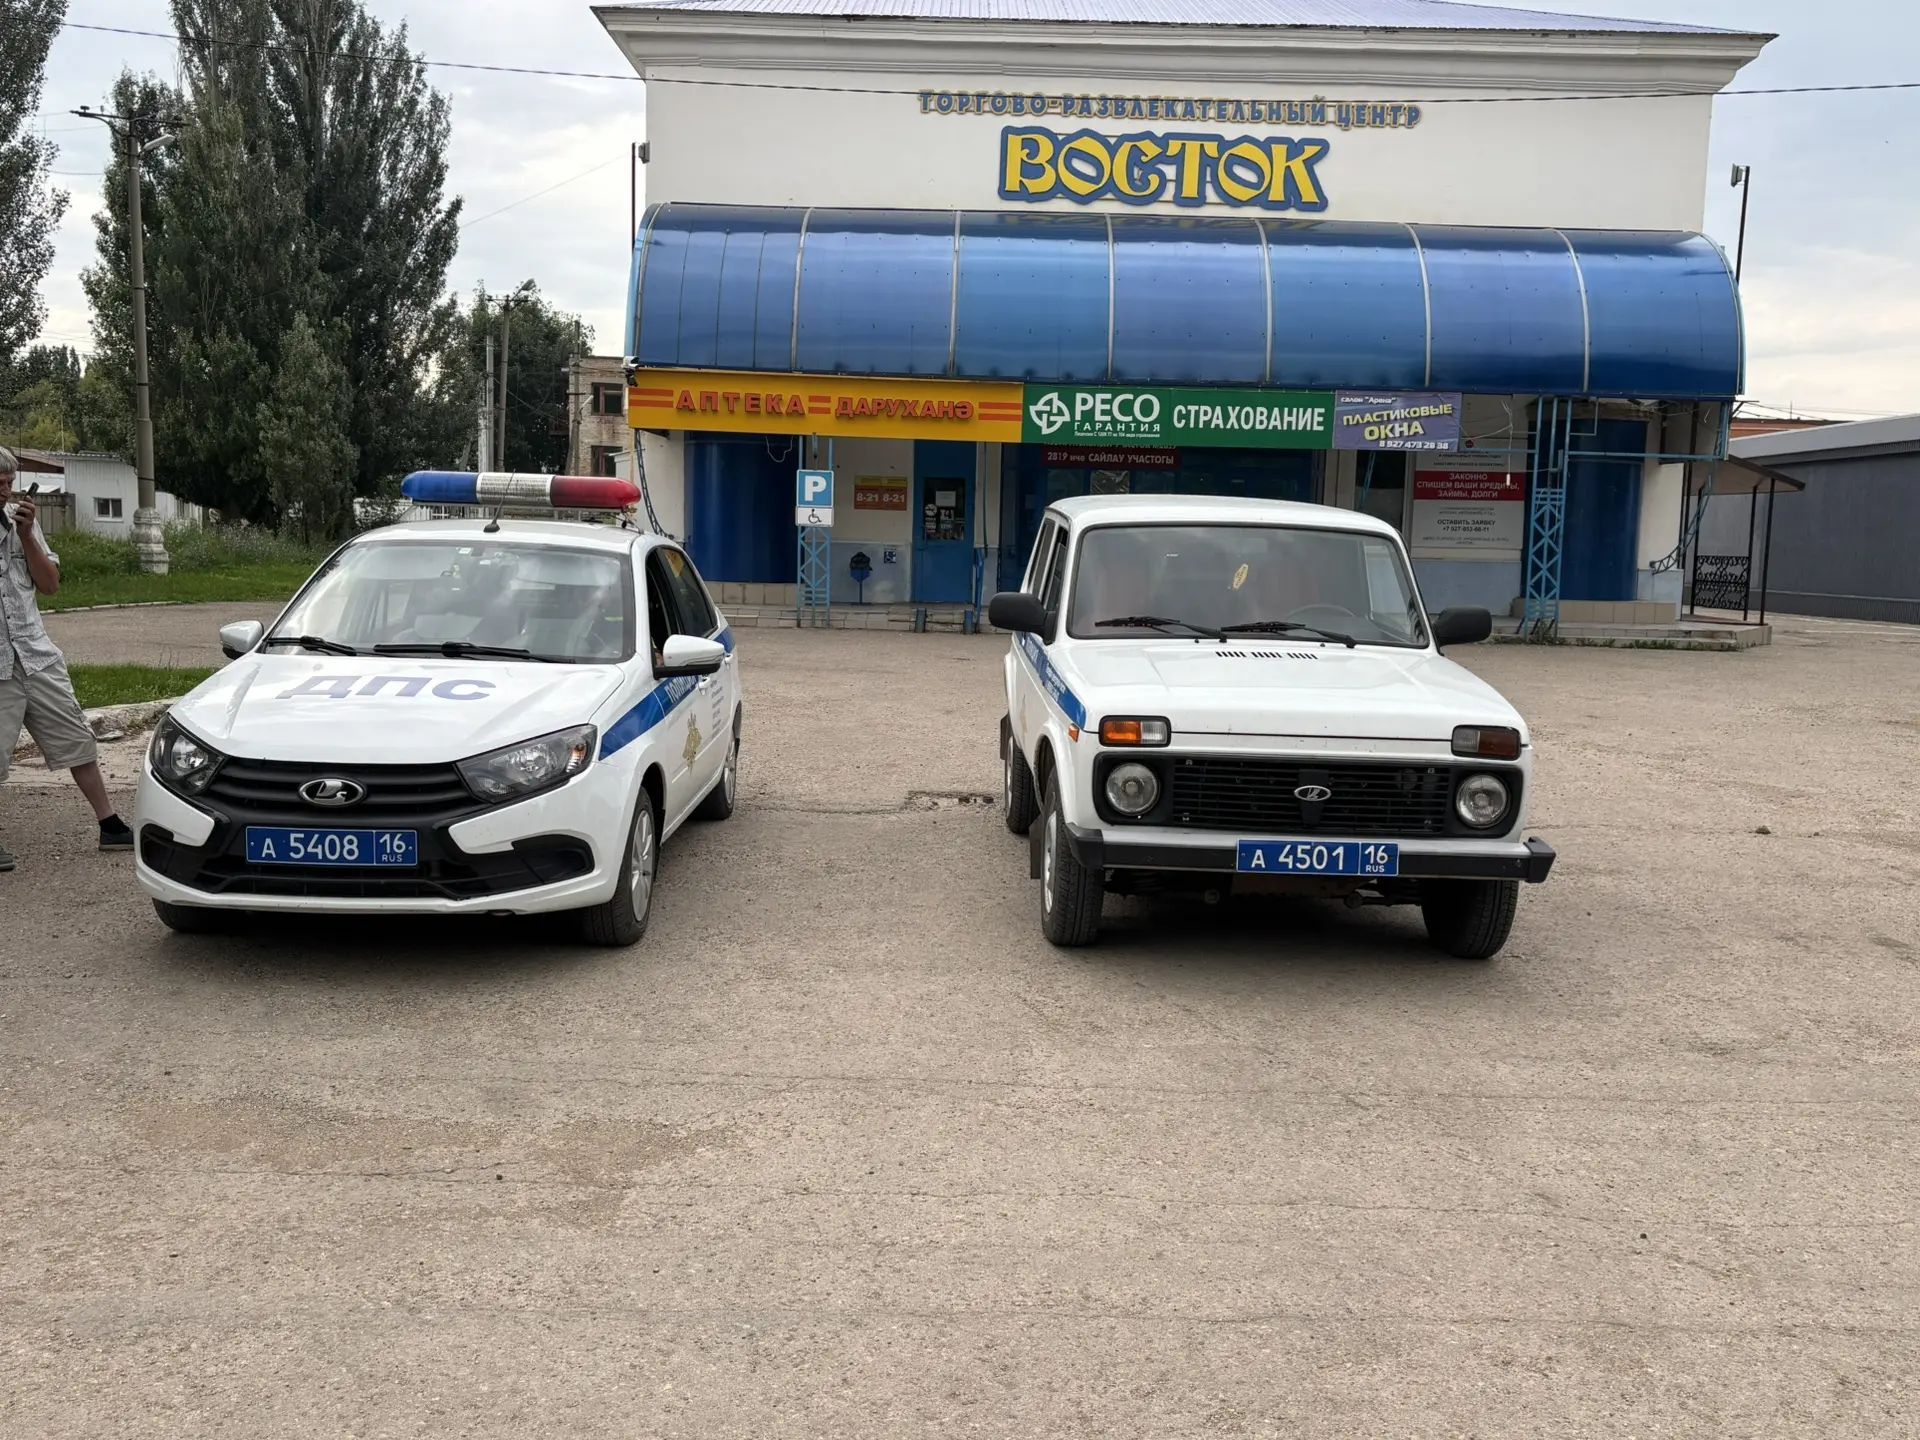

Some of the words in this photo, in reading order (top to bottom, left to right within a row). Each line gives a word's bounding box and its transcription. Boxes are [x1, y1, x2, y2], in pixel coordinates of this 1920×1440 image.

[918, 90, 1328, 124] ТОРГОВО-РАЗВЛЕКАТЕЛЬНЫЙ
[1335, 102, 1422, 131] ЦЕНТР
[1001, 128, 1327, 209] ВОСТОК
[675, 389, 806, 415] АПТЕКА
[1074, 392, 1160, 423] РЕСО
[1173, 404, 1326, 431] СТРАХОВАНИЕ
[1343, 404, 1453, 426] ПЛАСТИКОВЫЕ
[1074, 422, 1160, 432] ГАРАНТИЯ
[1364, 420, 1425, 441] ОКНА
[1088, 451, 1125, 463] САЙЛАУ
[1416, 480, 1453, 489] СПИШЕМ
[1454, 481, 1479, 489] ВАШИ
[1449, 472, 1488, 481] ЗАКОННО
[1471, 490, 1498, 499] ДОЛГИ
[274, 675, 497, 701] ДПС
[288, 833, 360, 861] 5408
[379, 833, 406, 854] 16
[1278, 844, 1345, 871] 4501
[1364, 845, 1389, 864] 16
[382, 854, 403, 863] RUS
[1365, 864, 1385, 873] RUS
